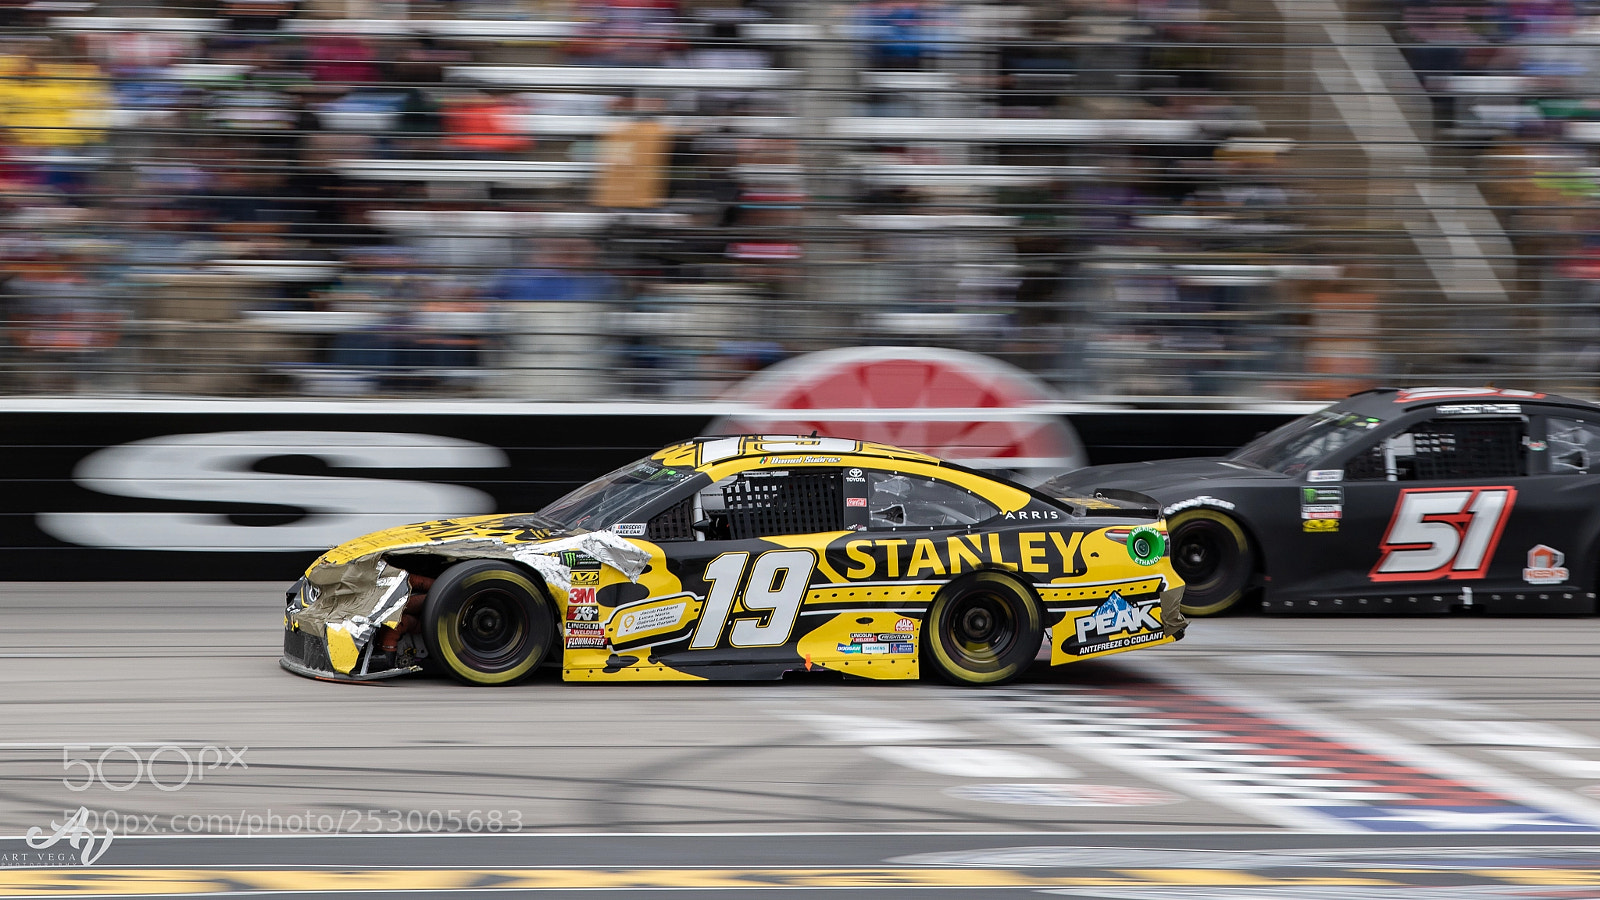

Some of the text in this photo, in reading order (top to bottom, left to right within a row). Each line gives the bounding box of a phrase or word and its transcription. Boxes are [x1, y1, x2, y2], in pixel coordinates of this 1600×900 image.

[1131, 526, 1161, 537] AMERICAN
[1372, 488, 1514, 580] 51
[845, 531, 1085, 579] STANLEY
[1134, 555, 1162, 566] ETHANOL
[569, 588, 596, 604] 3M
[689, 550, 817, 650] 19
[1075, 604, 1163, 644] PEAK
[567, 637, 606, 648] FLOWMASTER
[1079, 631, 1164, 654] ANTIFREEZE COOLANT
